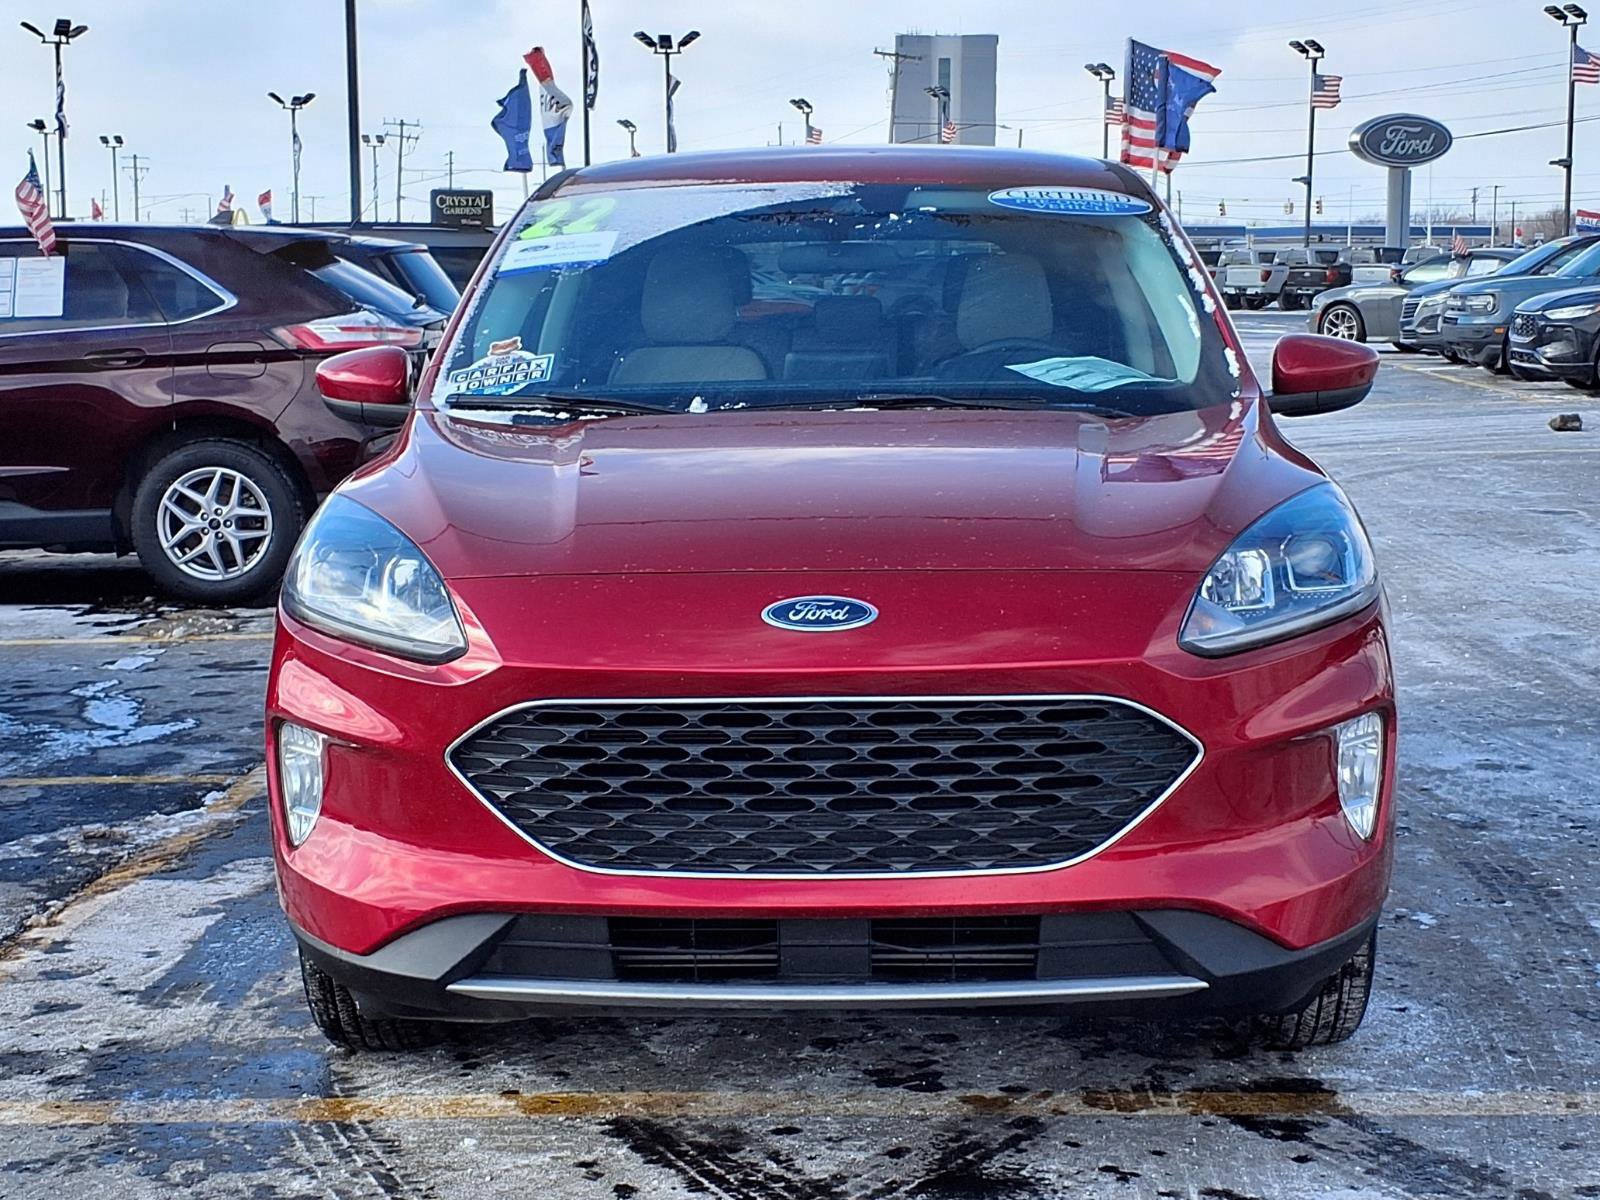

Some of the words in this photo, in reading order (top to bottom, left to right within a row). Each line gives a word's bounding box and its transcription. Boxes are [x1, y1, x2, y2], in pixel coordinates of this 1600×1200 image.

[1380, 125, 1436, 155] Ford
[436, 194, 490, 208] CRYSTAL
[1006, 190, 1132, 203] CERTIFIED
[443, 207, 482, 215] GARDENS
[519, 197, 616, 240] 22
[456, 361, 544, 382] CARFAX
[468, 370, 543, 389] OWNER
[788, 600, 850, 621] Ford
